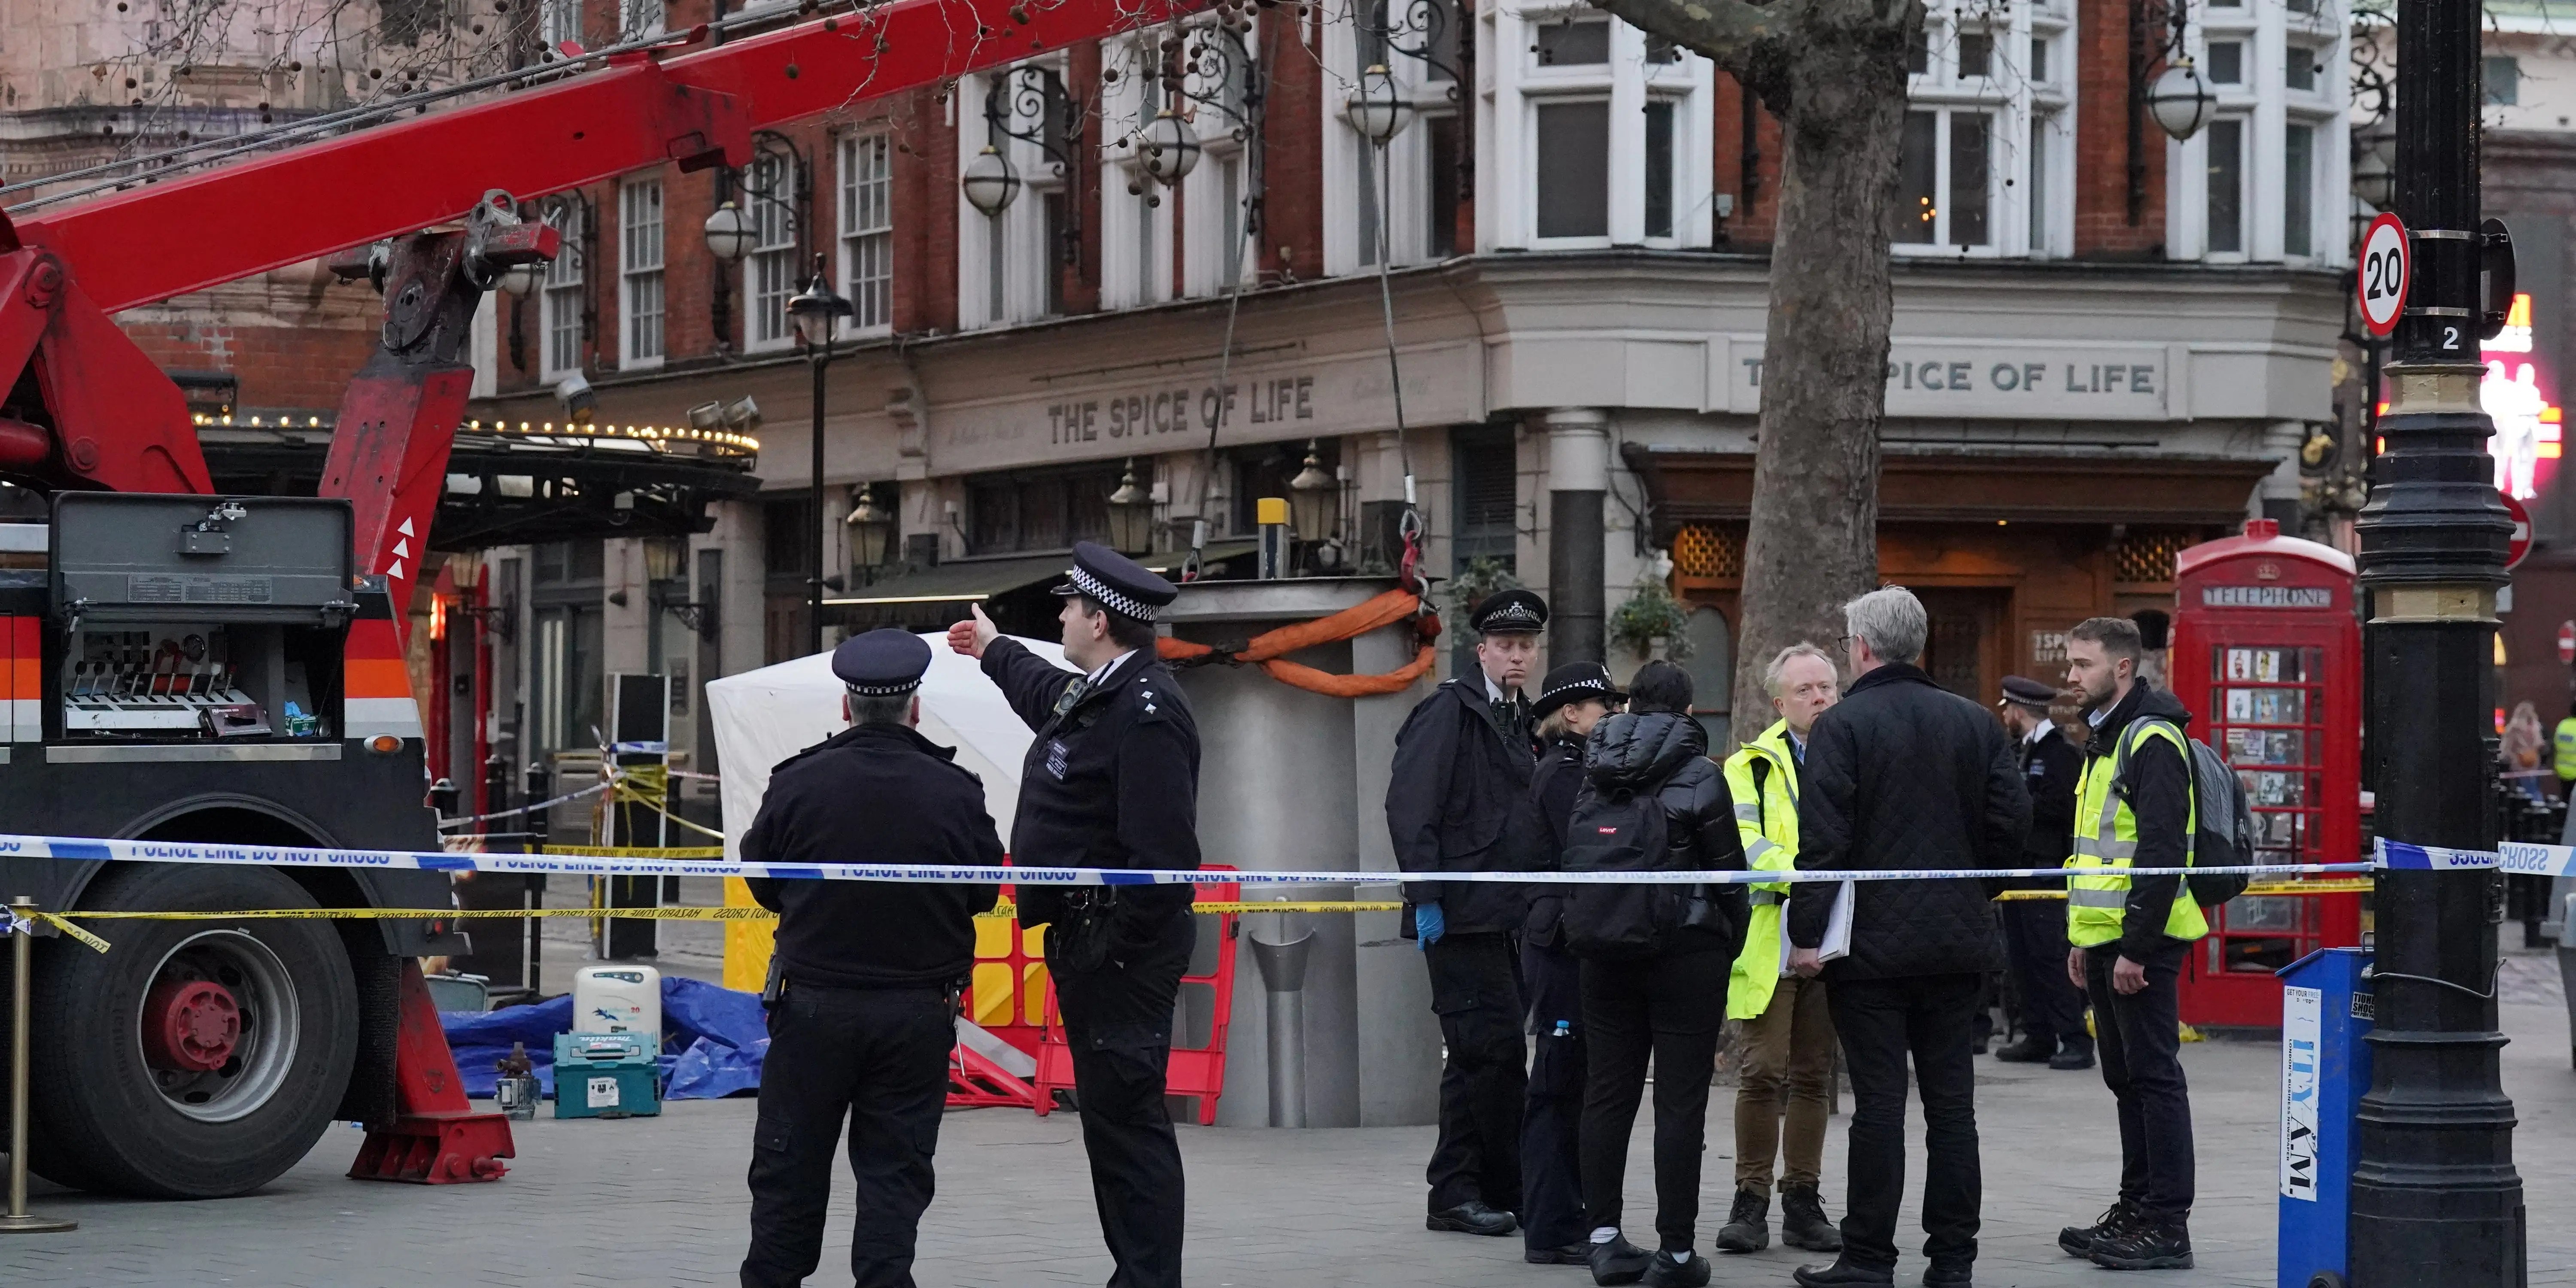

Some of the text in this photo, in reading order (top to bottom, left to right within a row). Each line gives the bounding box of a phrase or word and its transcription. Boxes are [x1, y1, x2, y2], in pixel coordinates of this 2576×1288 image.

[2367, 247, 2402, 300] 20
[2442, 327, 2459, 350] 2
[1991, 363, 2047, 391] OF
[2066, 364, 2154, 394] LIFE
[1048, 401, 1098, 444] THE
[1109, 389, 1189, 438] SPICE
[1200, 385, 1238, 428] OF
[1251, 377, 1314, 423] LIFE
[2205, 587, 2327, 604] TELEPHONE
